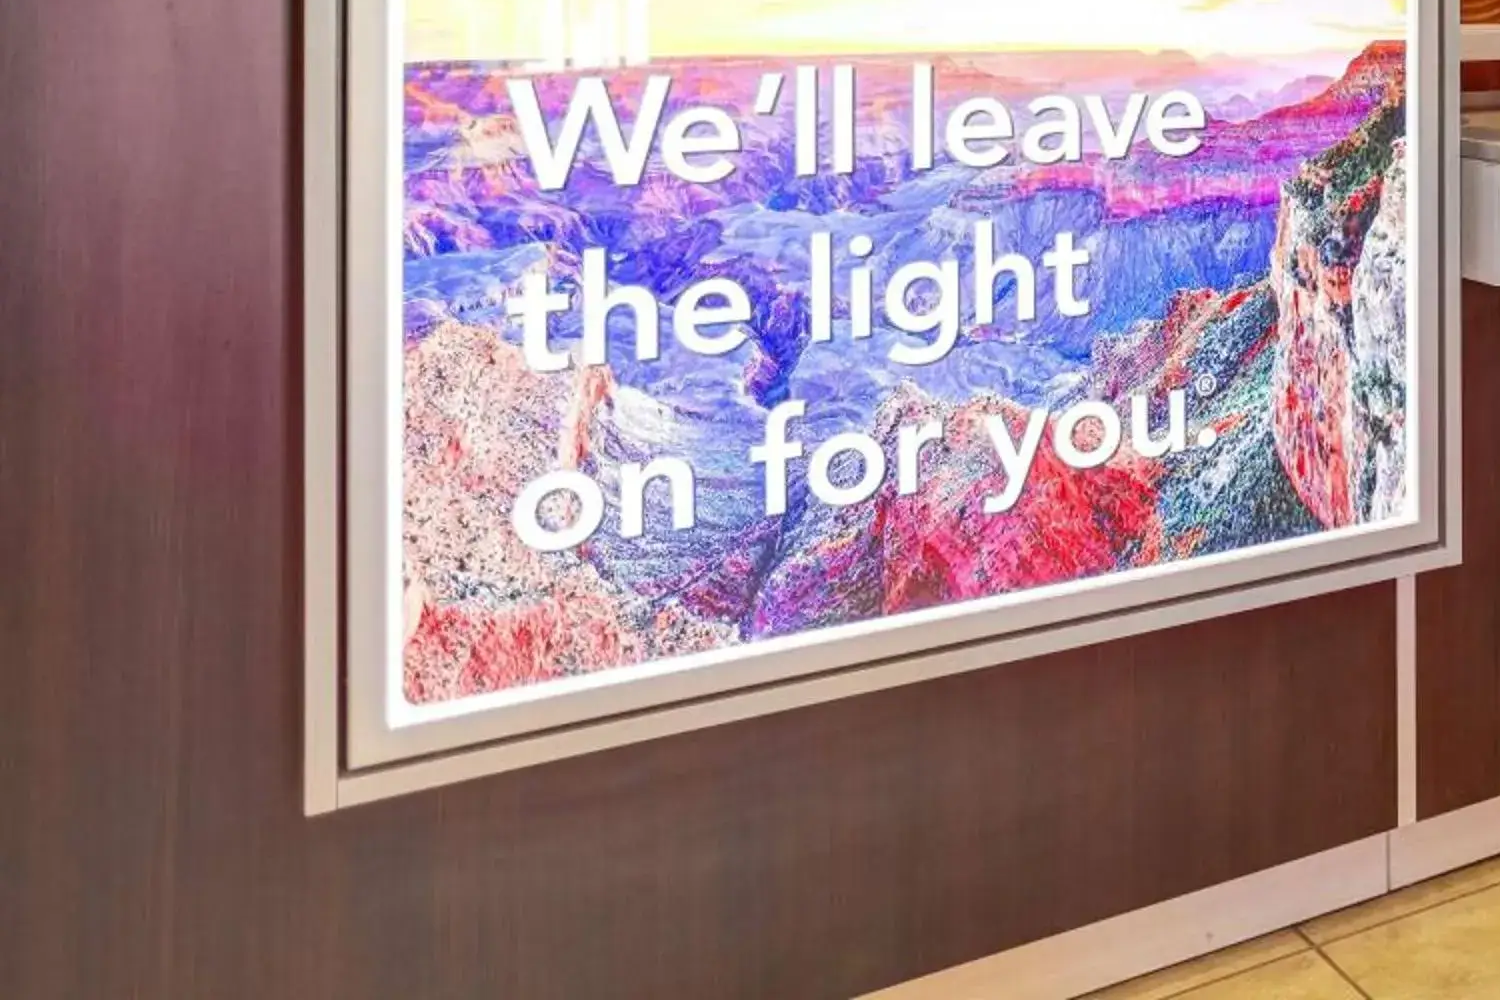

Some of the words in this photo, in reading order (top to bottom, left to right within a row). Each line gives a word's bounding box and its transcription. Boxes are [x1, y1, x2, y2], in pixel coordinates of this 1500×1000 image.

[505, 63, 857, 191] We'll
[912, 62, 1207, 170] leave
[505, 246, 754, 374] the
[809, 219, 1092, 366] light
[512, 453, 696, 552] on
[750, 400, 944, 516] for
